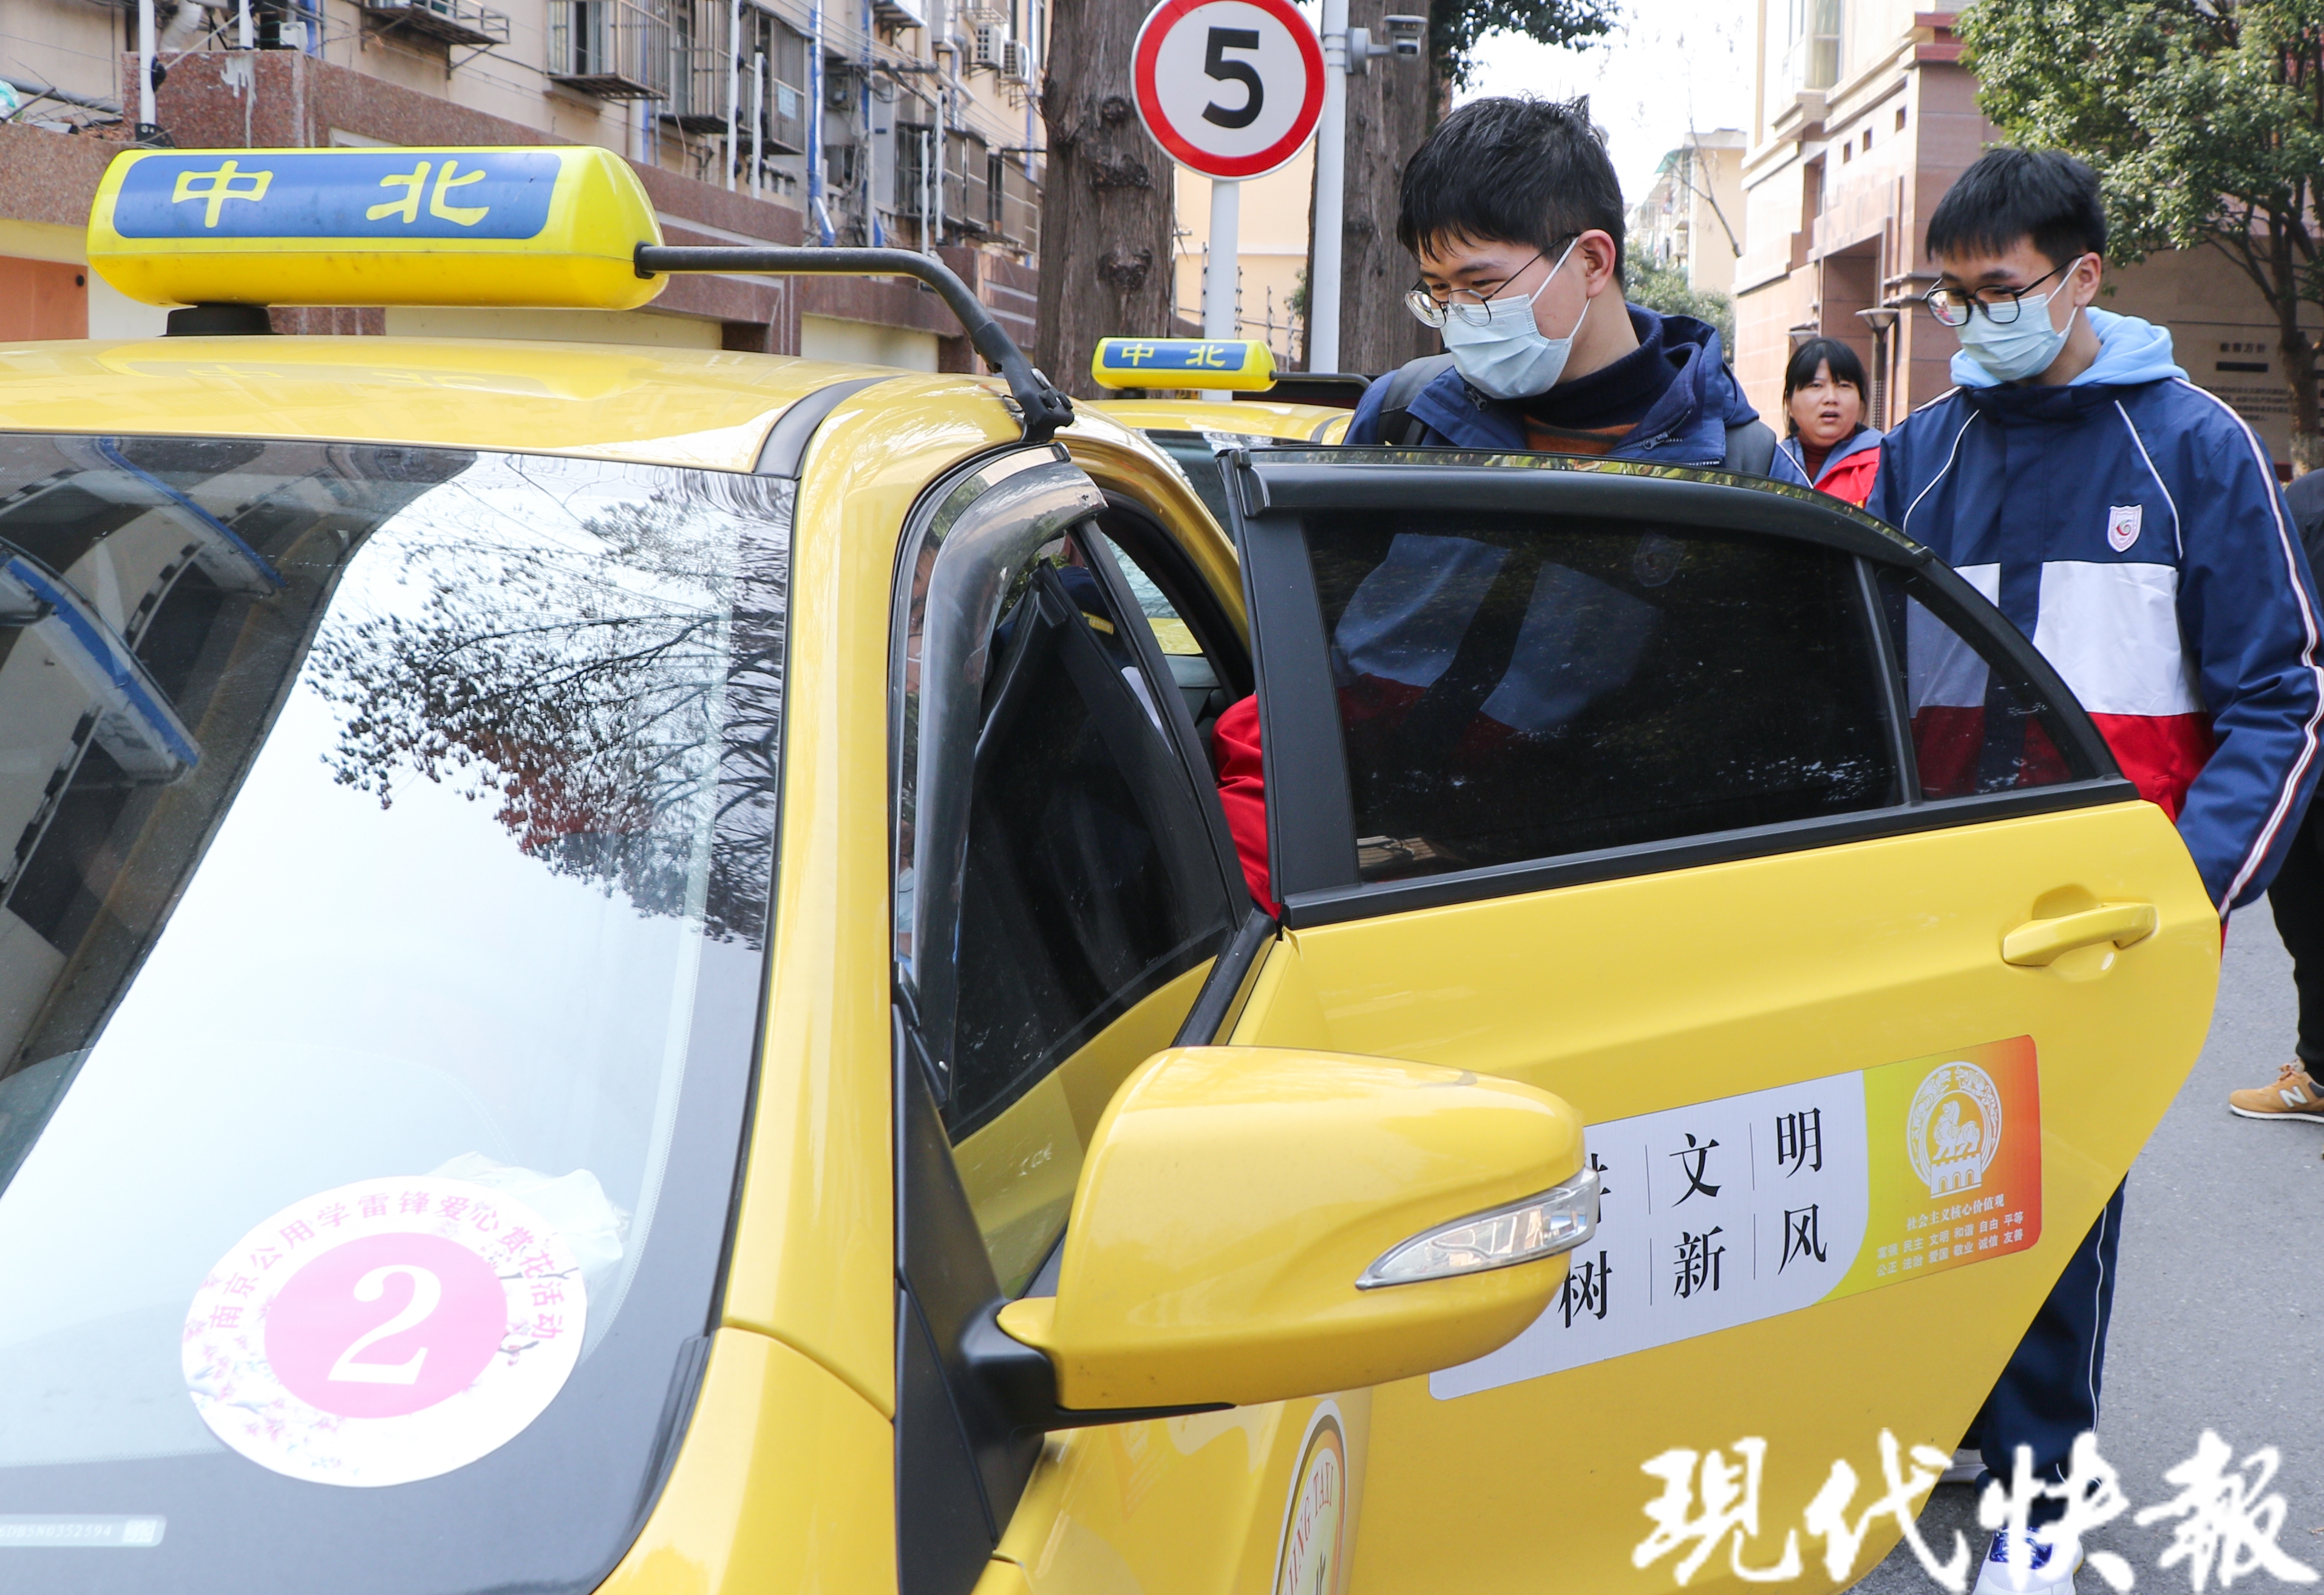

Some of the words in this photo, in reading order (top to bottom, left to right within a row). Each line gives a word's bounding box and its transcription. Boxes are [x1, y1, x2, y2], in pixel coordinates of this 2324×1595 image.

[1201, 26, 1264, 129] 5
[172, 160, 489, 229] 中北
[1121, 343, 1226, 368] 中北
[2278, 1085, 2308, 1108] N
[1877, 1243, 1898, 1260] 富强
[1903, 1238, 1924, 1253] 民主
[1929, 1230, 1950, 1246] 文明
[1954, 1224, 1974, 1239] 和谐
[1980, 1217, 1999, 1234] 自由
[2003, 1211, 2023, 1227] 平等
[1906, 1193, 2005, 1231] 社会主义核心价值观
[208, 1190, 565, 1340] 南京公用学雷锋爱心赏花活动
[1557, 1203, 1827, 1329] 树新风
[1877, 1261, 1898, 1278] 公正
[1903, 1255, 1923, 1270] 法治
[1929, 1247, 1949, 1264] 爱国
[1953, 1241, 1974, 1257] 敬业
[1979, 1234, 1999, 1251] 诚信
[2003, 1228, 2023, 1244] 友善
[327, 1264, 442, 1384] 2
